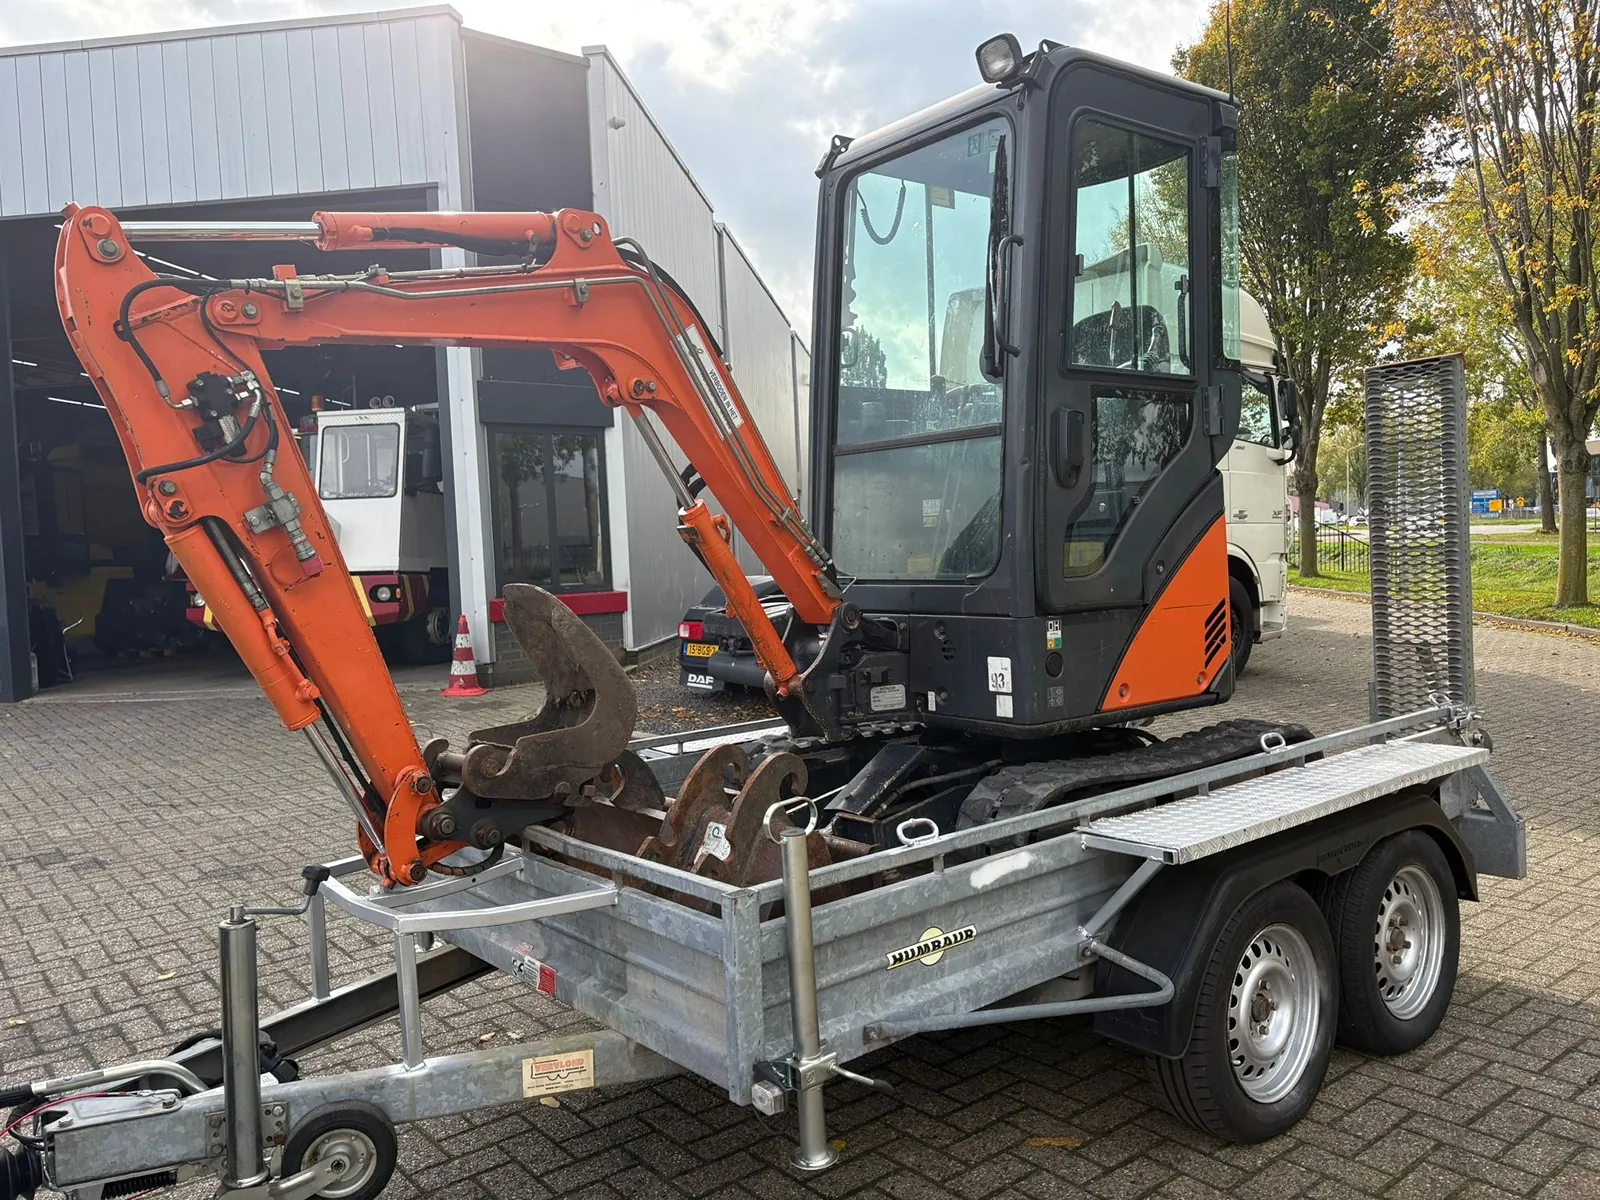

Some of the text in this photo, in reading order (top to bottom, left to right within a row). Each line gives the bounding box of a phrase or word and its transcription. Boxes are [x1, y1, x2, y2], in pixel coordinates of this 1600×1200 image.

[708, 369, 739, 420] VERBODEN IN HET
[687, 673, 715, 685] DAF
[990, 672, 1006, 689] 93
[891, 928, 975, 966] HUMBAUR
